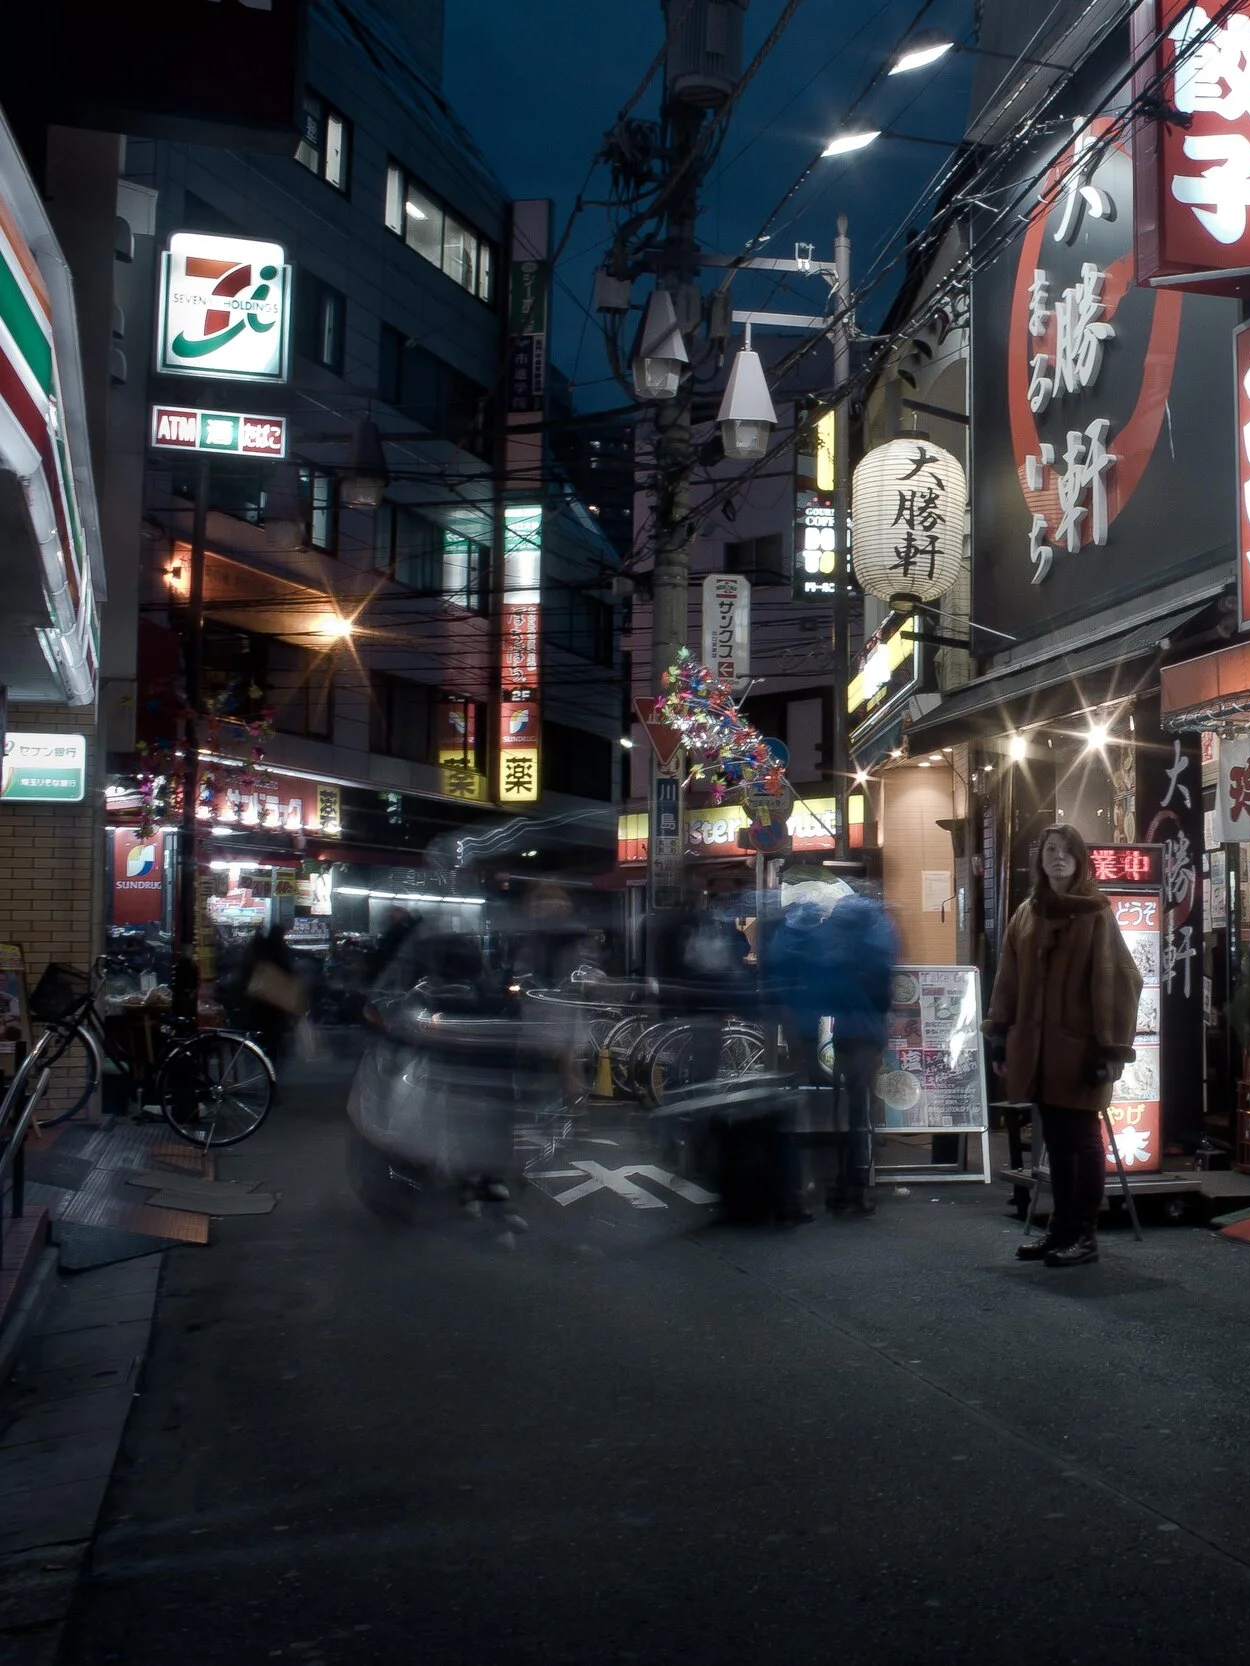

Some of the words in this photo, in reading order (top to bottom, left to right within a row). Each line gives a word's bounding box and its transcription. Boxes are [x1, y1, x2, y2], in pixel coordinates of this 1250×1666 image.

[223, 300, 279, 313] HOLDINGS
[1053, 114, 1118, 554] 大勝軒
[157, 414, 197, 442] ATM
[888, 445, 946, 581] 大勝軒
[718, 600, 735, 658] サンクス
[511, 690, 531, 701] 2F
[505, 756, 533, 795] 薬
[659, 783, 676, 831] 川島
[116, 880, 162, 890] SUNDRUG
[1160, 738, 1198, 999] 大勝軒
[1115, 901, 1157, 926] どうぞ
